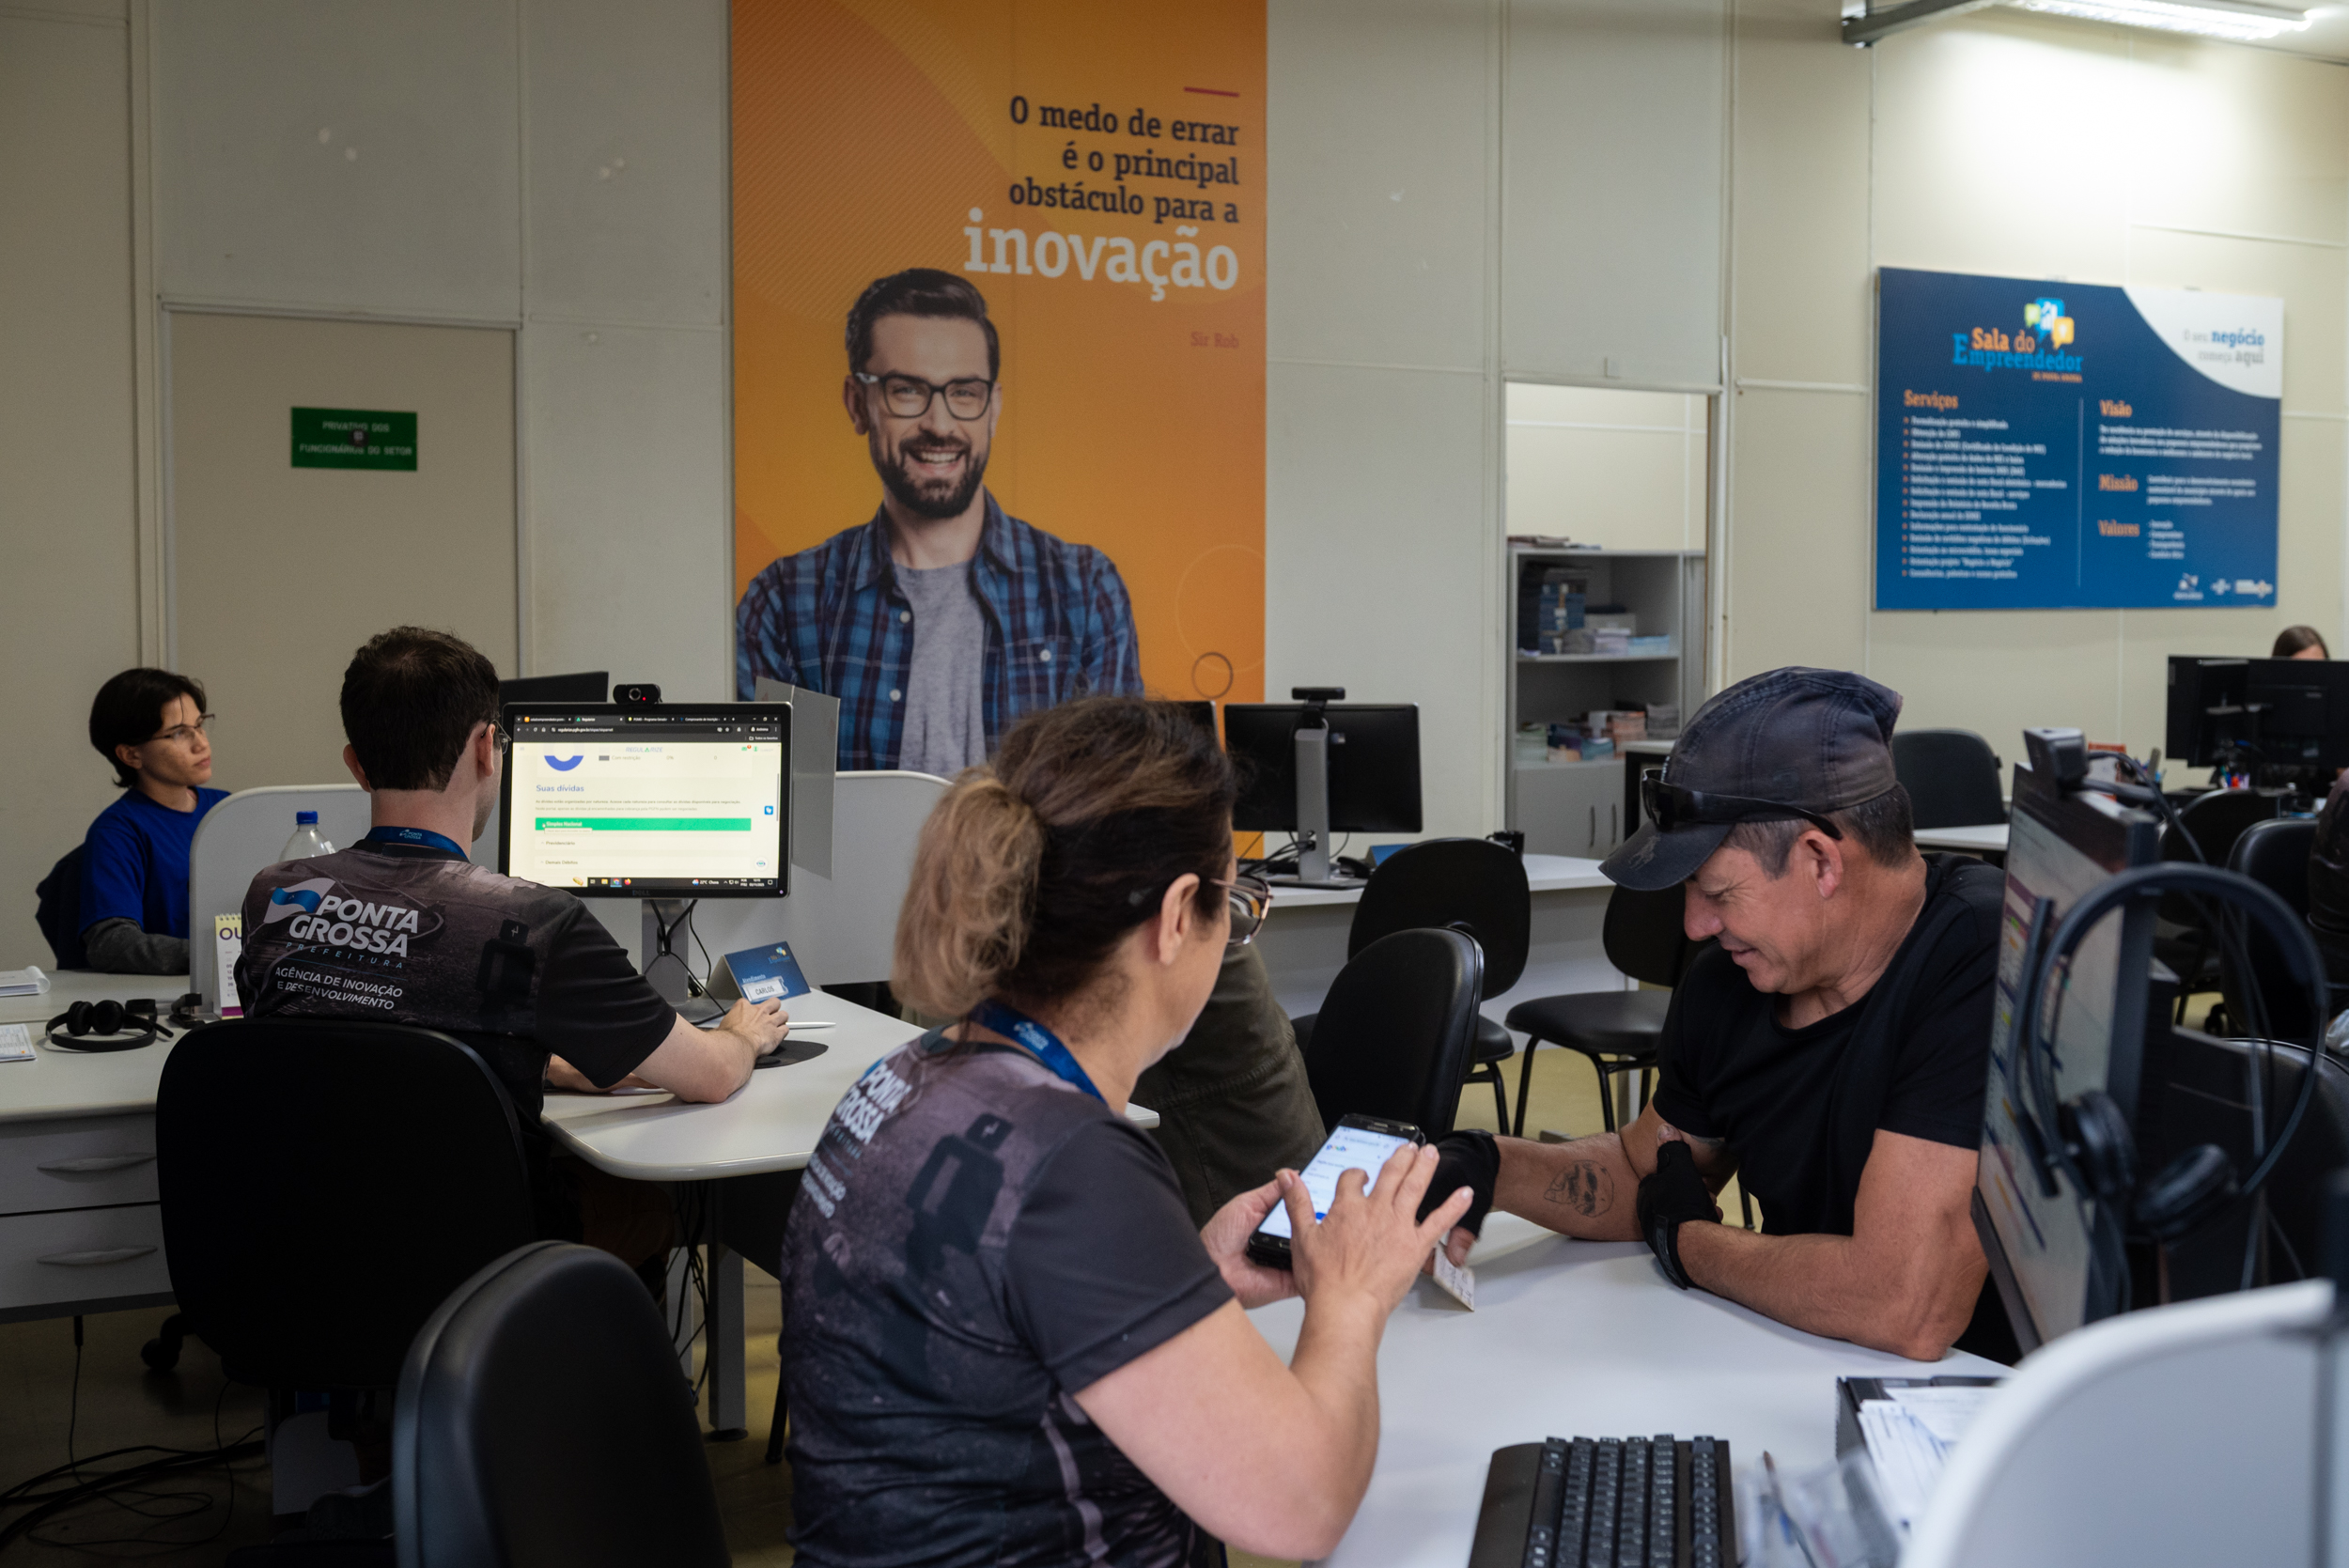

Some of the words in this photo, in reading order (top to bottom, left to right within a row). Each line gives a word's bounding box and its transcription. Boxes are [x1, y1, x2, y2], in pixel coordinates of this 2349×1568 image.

[1010, 96, 1029, 124] O
[1039, 103, 1118, 134] medo
[1128, 108, 1161, 138] de
[1171, 119, 1239, 146] errar
[1063, 141, 1078, 169] é
[1088, 150, 1104, 172] o
[1113, 148, 1239, 189] principal
[1009, 177, 1144, 215] obstáculo
[1153, 195, 1215, 225] para
[1223, 202, 1239, 224] a
[964, 207, 1239, 302] inovação
[1971, 326, 2010, 352] Sala
[2014, 329, 2036, 353] do
[2211, 327, 2265, 349] negócio
[1952, 333, 2084, 373] Empreendedor
[2235, 348, 2264, 367] aqui
[1904, 389, 1959, 412] Serviços
[2099, 399, 2133, 418] Visão
[371, 423, 390, 433] DOS
[367, 445, 381, 456] DO
[383, 446, 412, 457] SETOR
[2098, 474, 2139, 492] Missão
[2097, 519, 2140, 537] Valores
[315, 894, 419, 934] PONTA
[288, 914, 408, 958] GROSSA
[286, 941, 403, 969] PREFEITURA
[275, 966, 321, 984] AGÊNCIA
[323, 975, 342, 987] DE
[342, 979, 403, 998] INOVAÇÃO
[277, 981, 284, 990] E
[285, 982, 395, 1010] DESENVOLVIMENTO
[755, 986, 775, 995] CARLOS
[859, 1063, 913, 1114] PONTA
